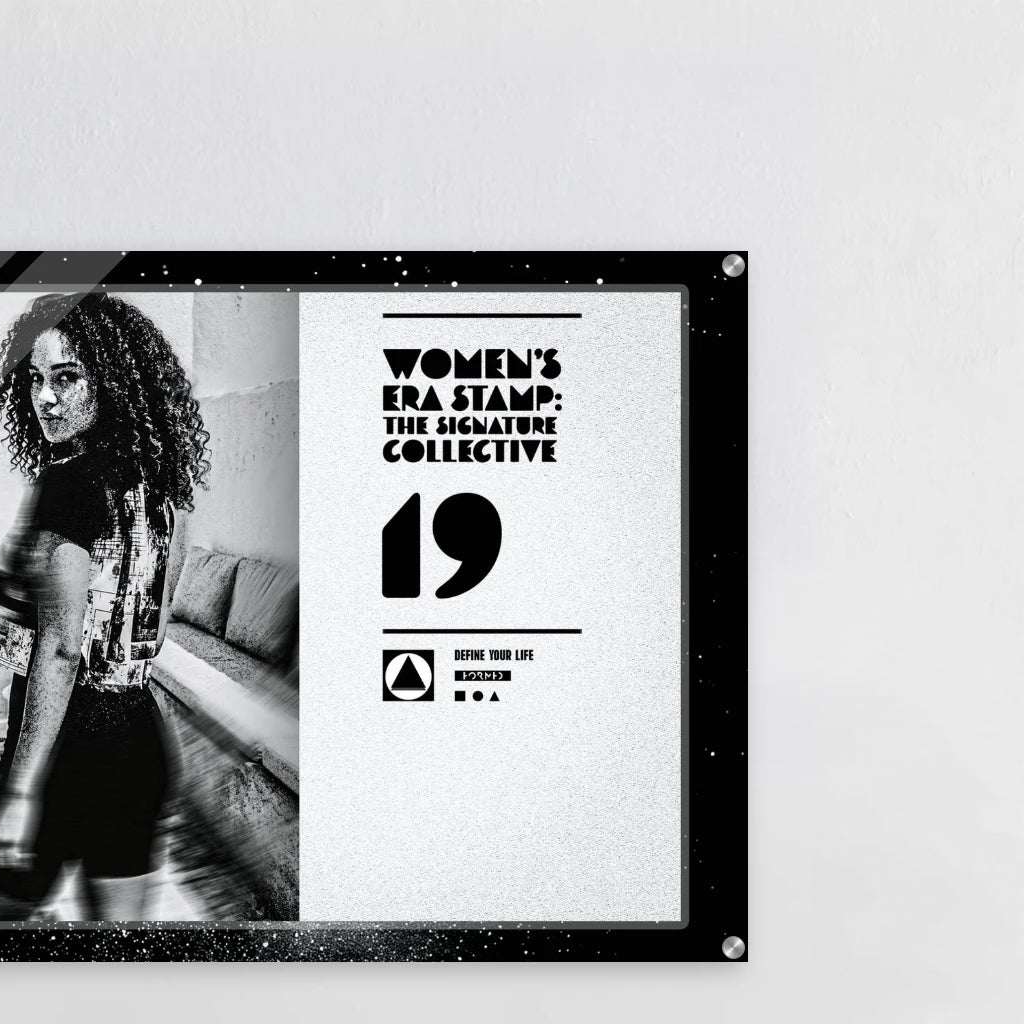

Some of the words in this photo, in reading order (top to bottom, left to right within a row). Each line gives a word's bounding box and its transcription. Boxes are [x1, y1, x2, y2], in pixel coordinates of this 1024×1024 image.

[383, 348, 561, 379] WOMEN'S
[383, 385, 443, 411] ERA
[451, 385, 562, 411] STAMP:
[383, 417, 429, 434] THE
[436, 417, 557, 434] SIGNATURE
[383, 440, 557, 463] COLLECTIVE
[382, 493, 502, 599] 19
[455, 649, 485, 661] DEFINE
[488, 649, 512, 661] YOUR
[515, 649, 534, 661] LIFE
